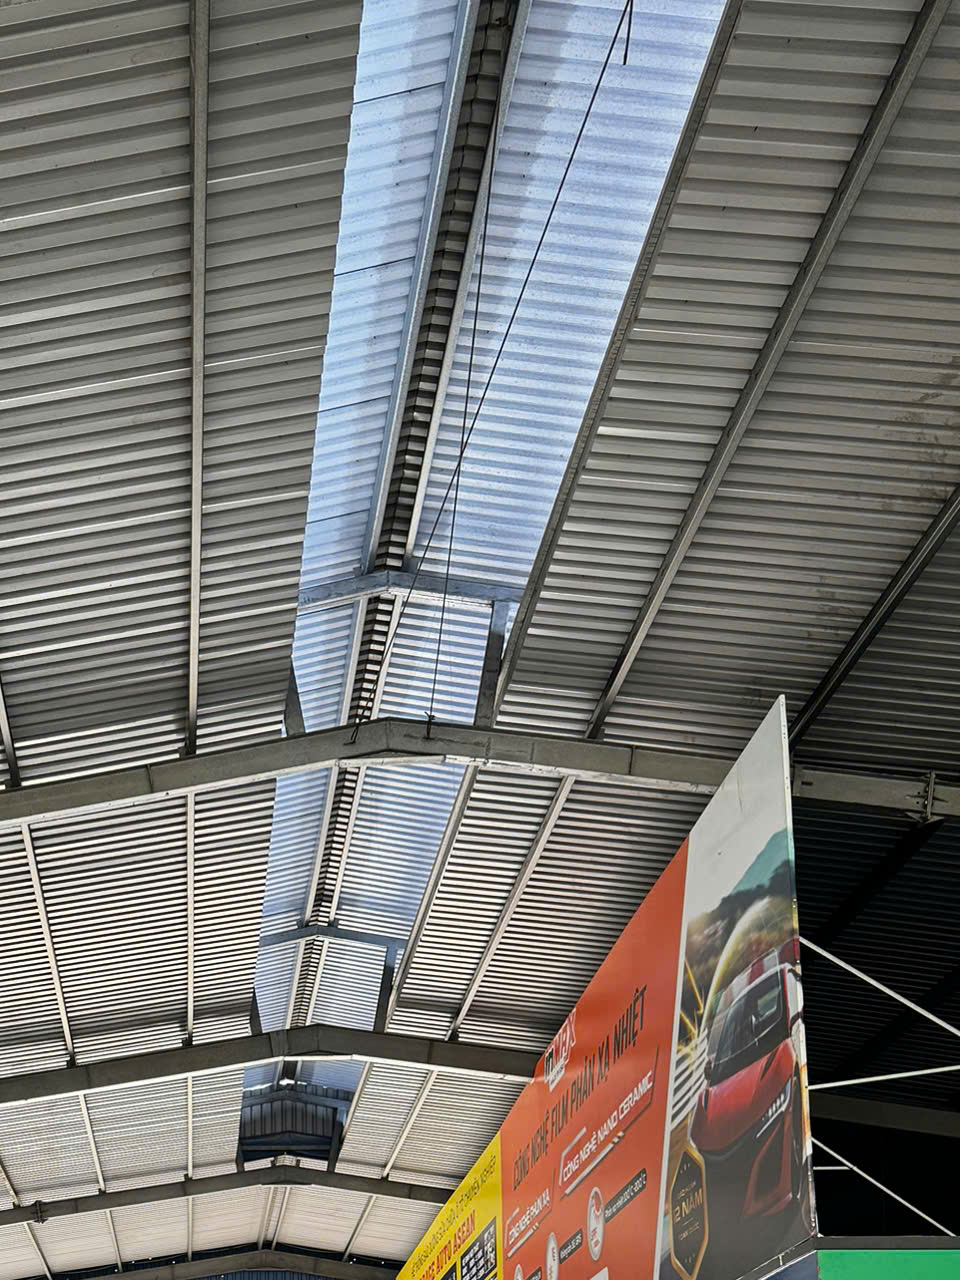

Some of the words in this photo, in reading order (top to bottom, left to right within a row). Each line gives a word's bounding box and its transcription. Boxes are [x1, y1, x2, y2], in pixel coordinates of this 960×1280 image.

[550, 1088, 569, 1143] FILM
[613, 985, 647, 1064] NHIỆT
[597, 1110, 618, 1144] NANO
[619, 1070, 653, 1120] CERAMIC
